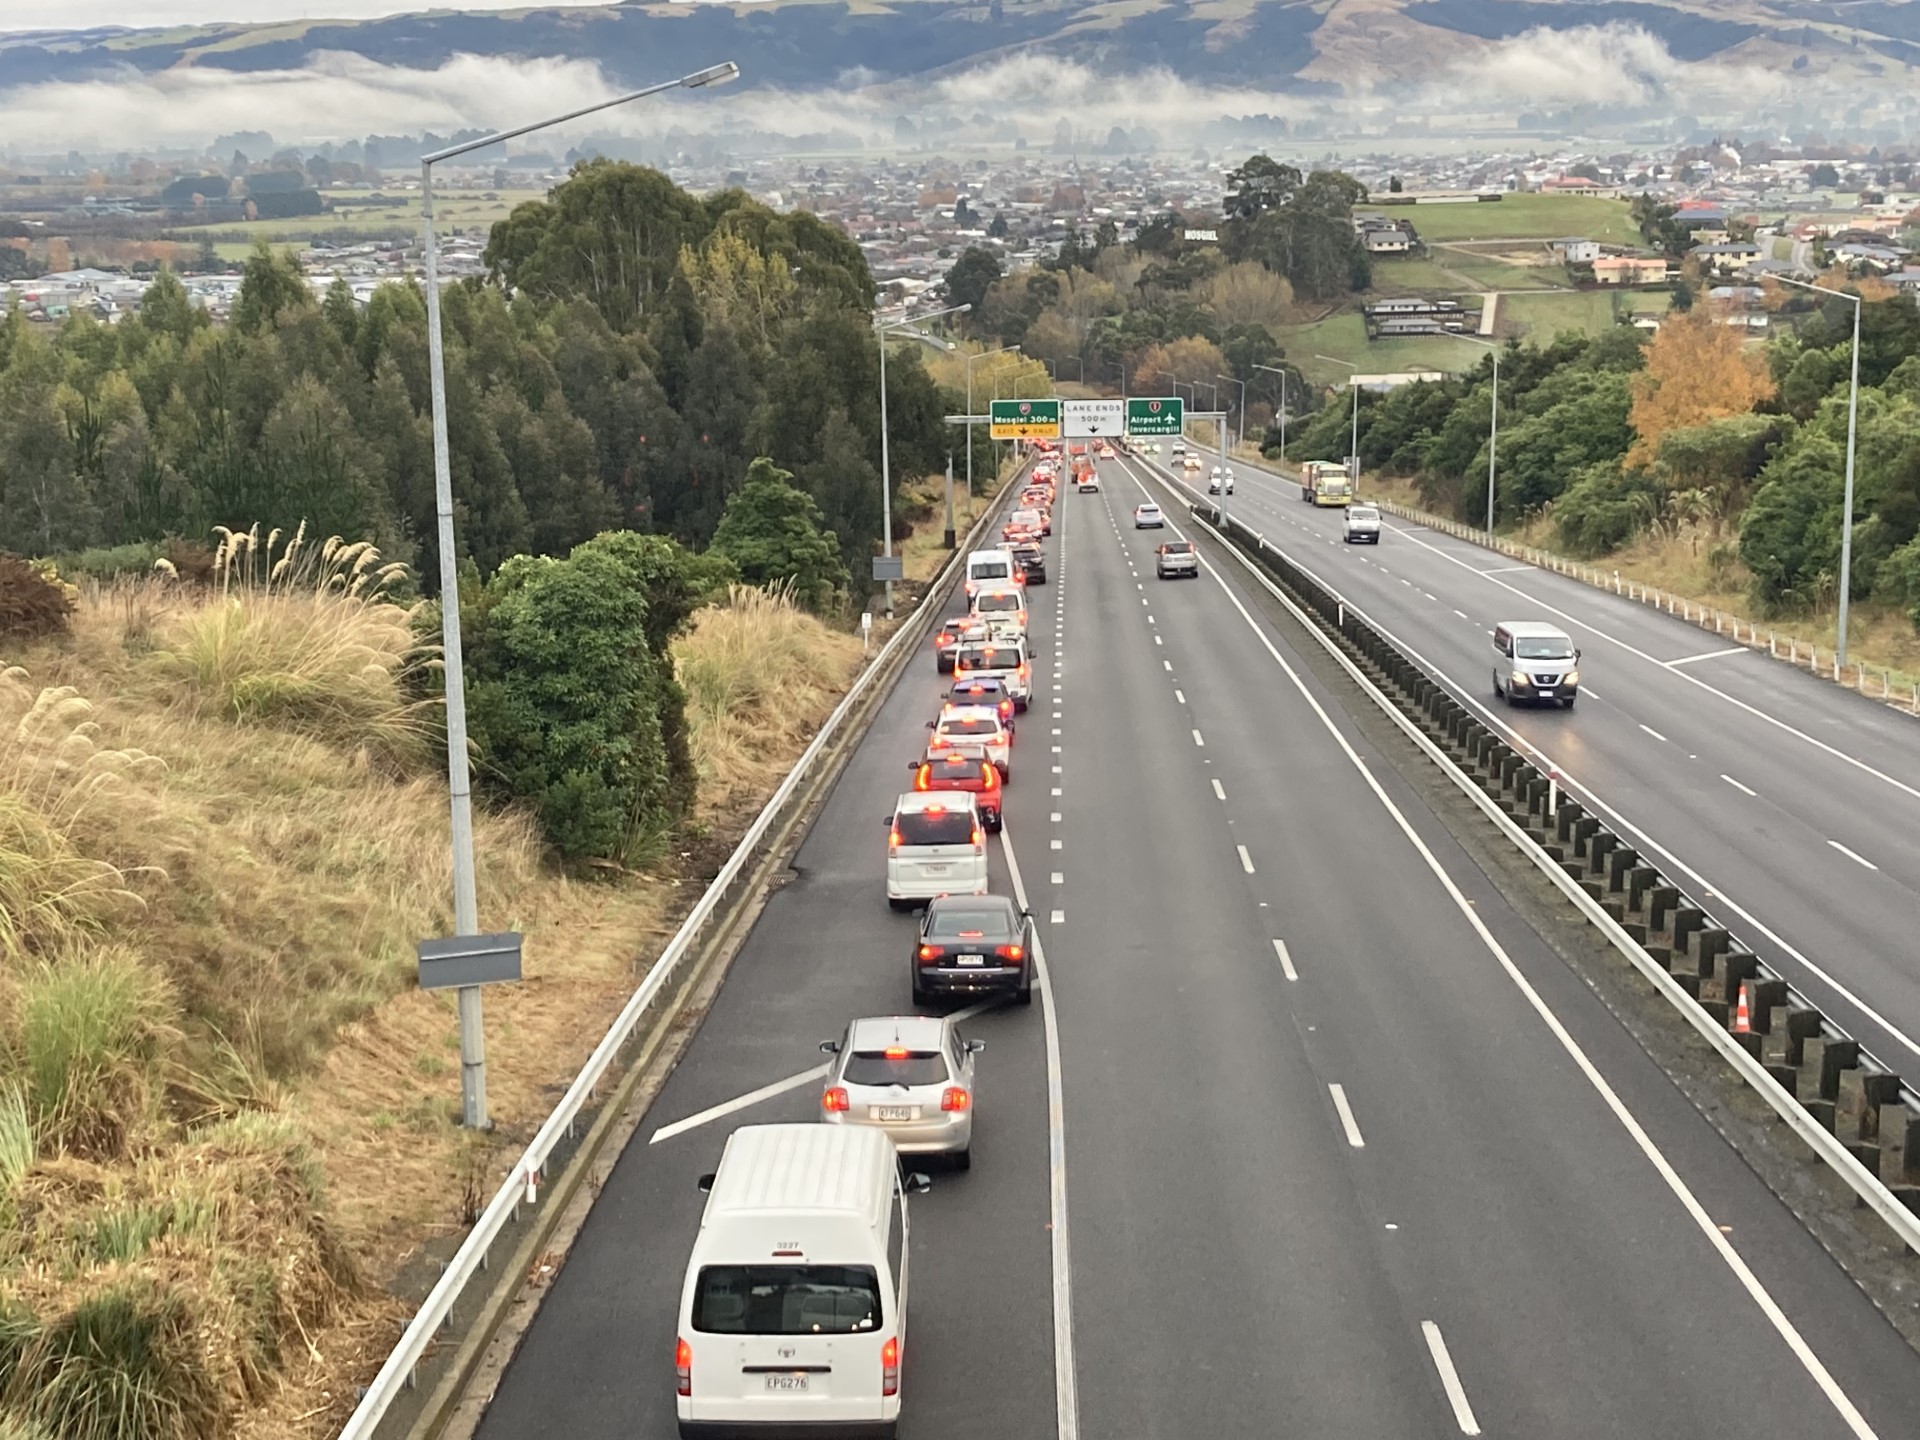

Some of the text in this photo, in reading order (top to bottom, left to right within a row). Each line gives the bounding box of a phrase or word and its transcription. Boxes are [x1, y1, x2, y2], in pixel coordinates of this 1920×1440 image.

[1095, 404, 1121, 412] ENDS
[994, 416, 1027, 425] Mosgiel
[1030, 415, 1048, 423] 300
[1130, 416, 1162, 425] Airport
[1130, 425, 1180, 434] Invercargill
[767, 1377, 807, 1389] EPG276
